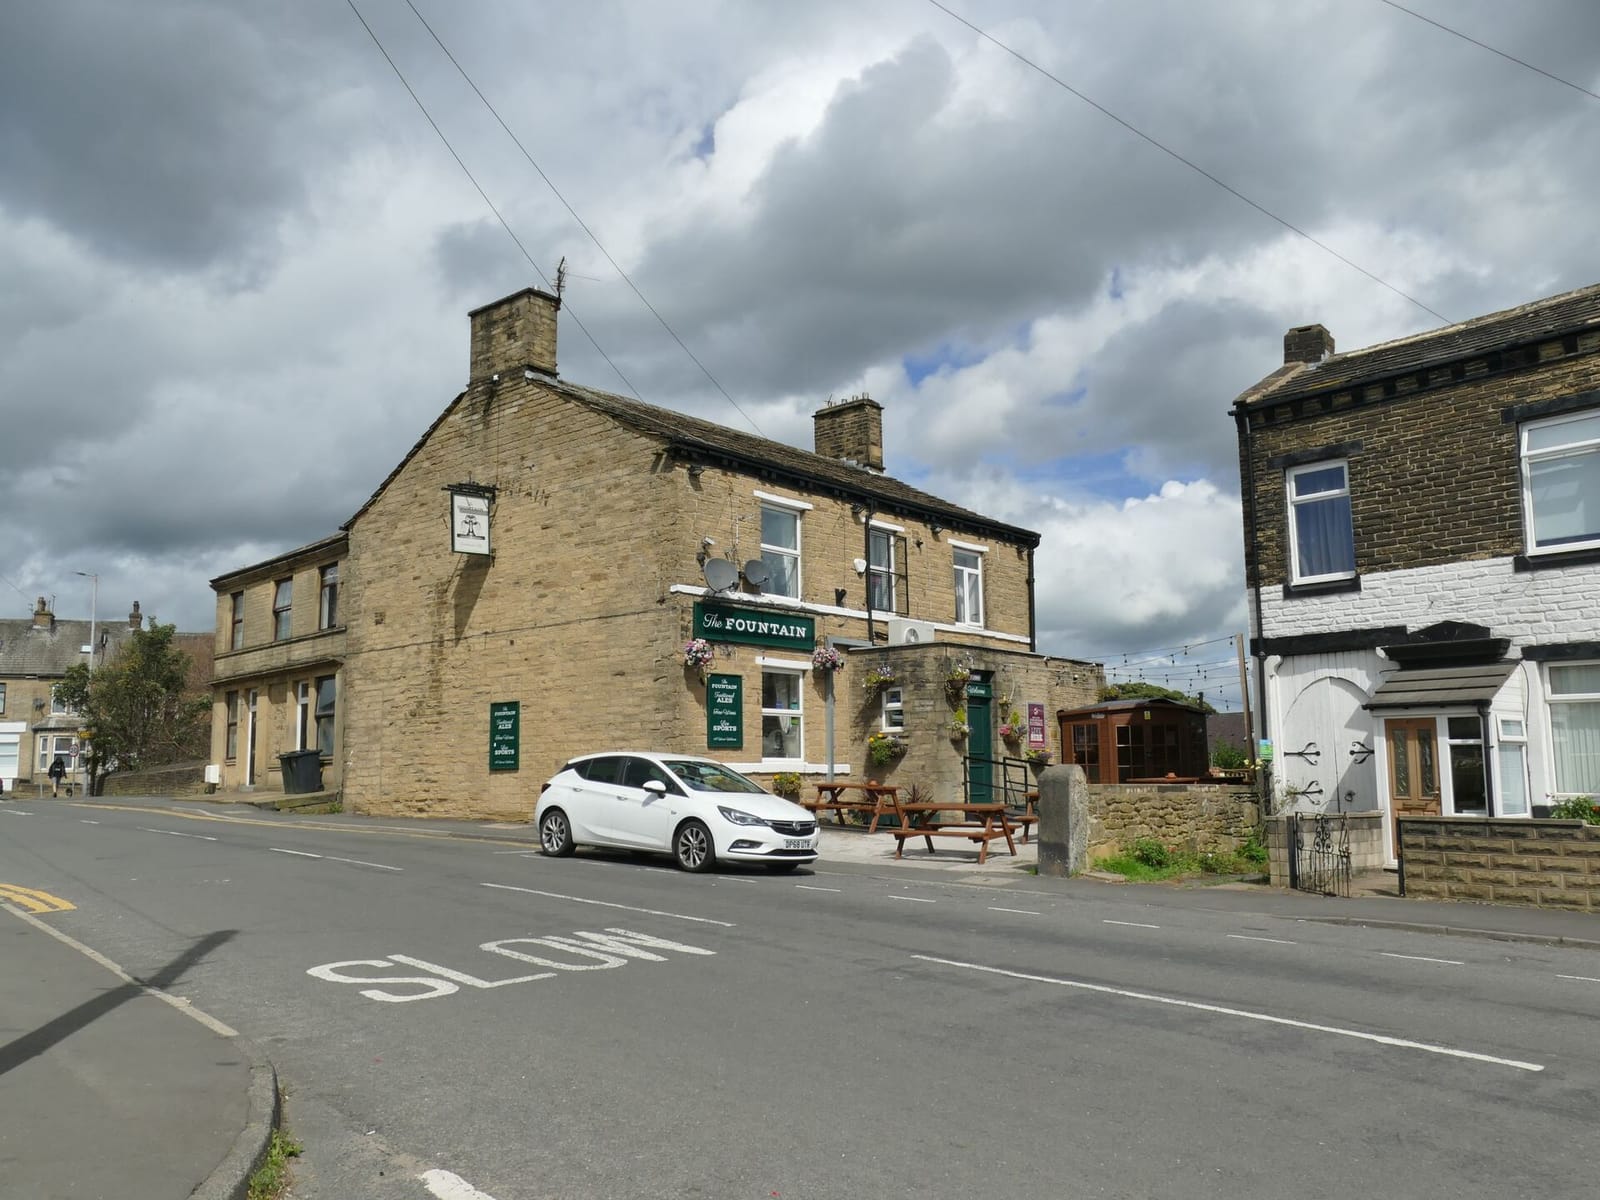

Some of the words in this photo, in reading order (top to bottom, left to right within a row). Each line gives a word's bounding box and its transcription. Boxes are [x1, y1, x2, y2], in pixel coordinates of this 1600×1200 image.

[702, 613, 723, 629] The
[725, 618, 806, 638] FOUNTAIN
[306, 927, 719, 1003] SLOW
